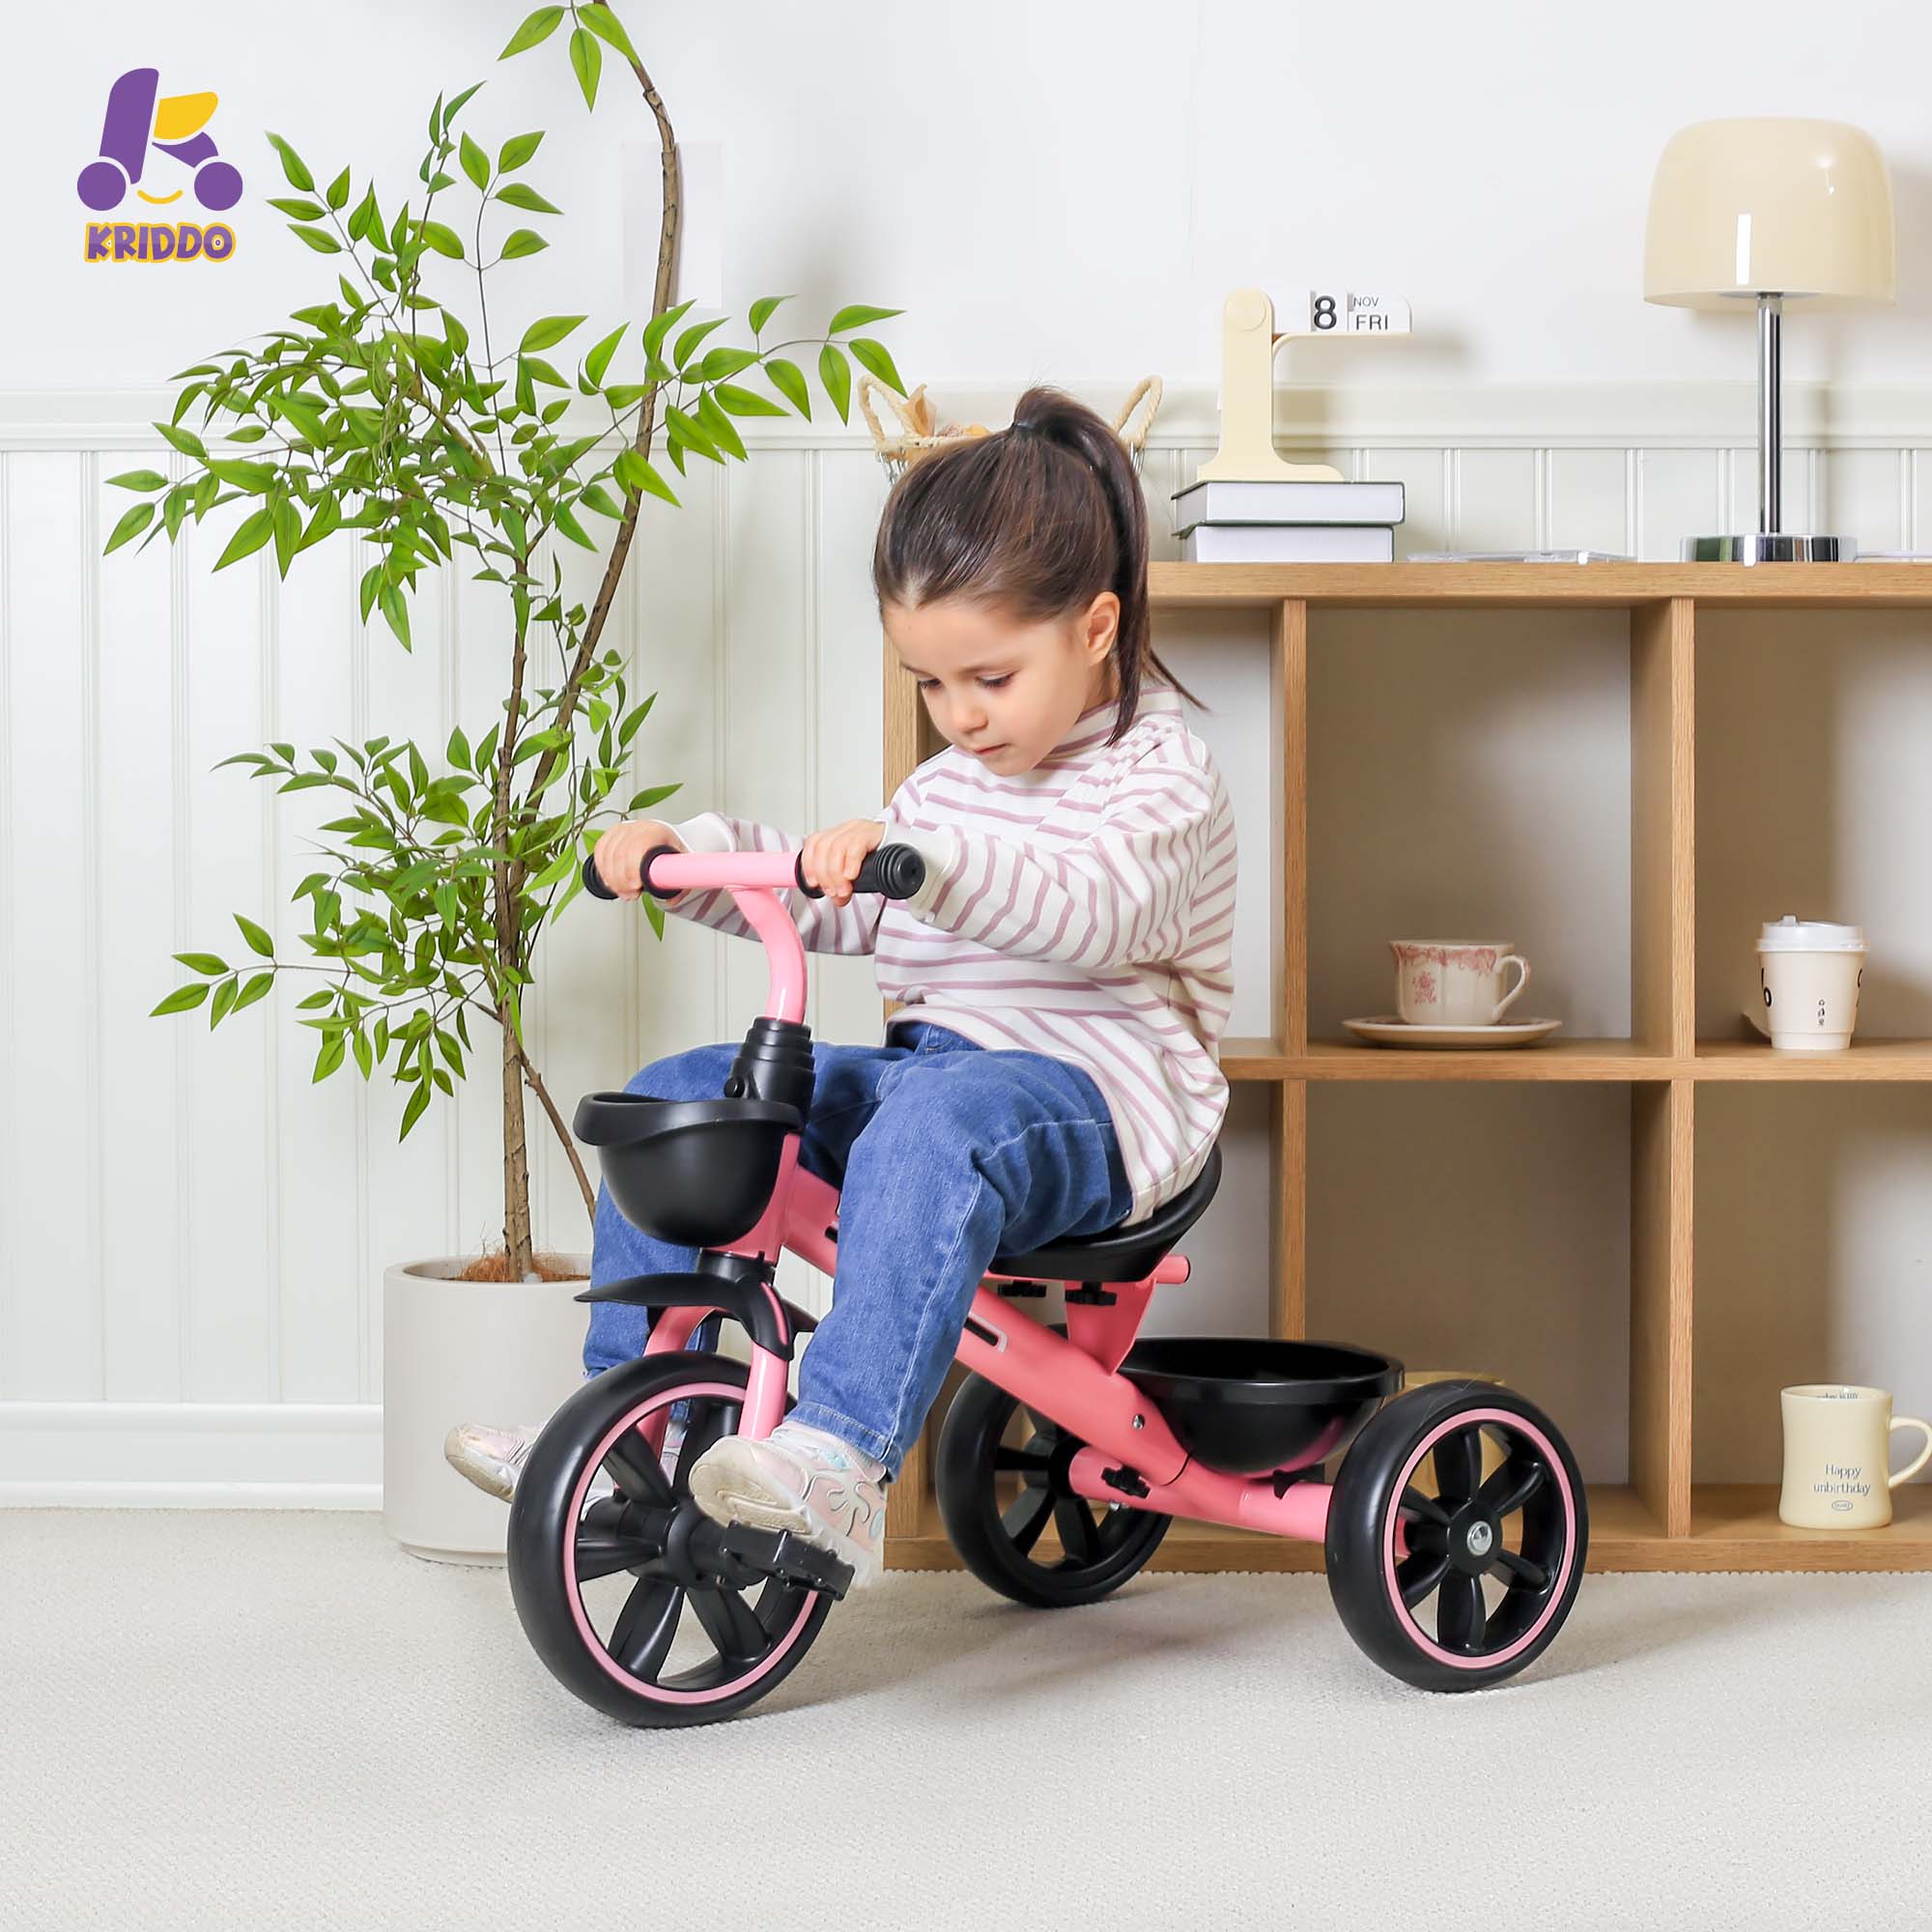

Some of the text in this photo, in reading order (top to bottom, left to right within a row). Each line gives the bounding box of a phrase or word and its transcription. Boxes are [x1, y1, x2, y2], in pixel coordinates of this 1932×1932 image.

[1353, 296, 1379, 307] NOV
[1314, 295, 1337, 330] 8
[1355, 314, 1388, 330] FRI
[1825, 1463, 1862, 1480] Happy
[1813, 1481, 1871, 1497] unbirthday
